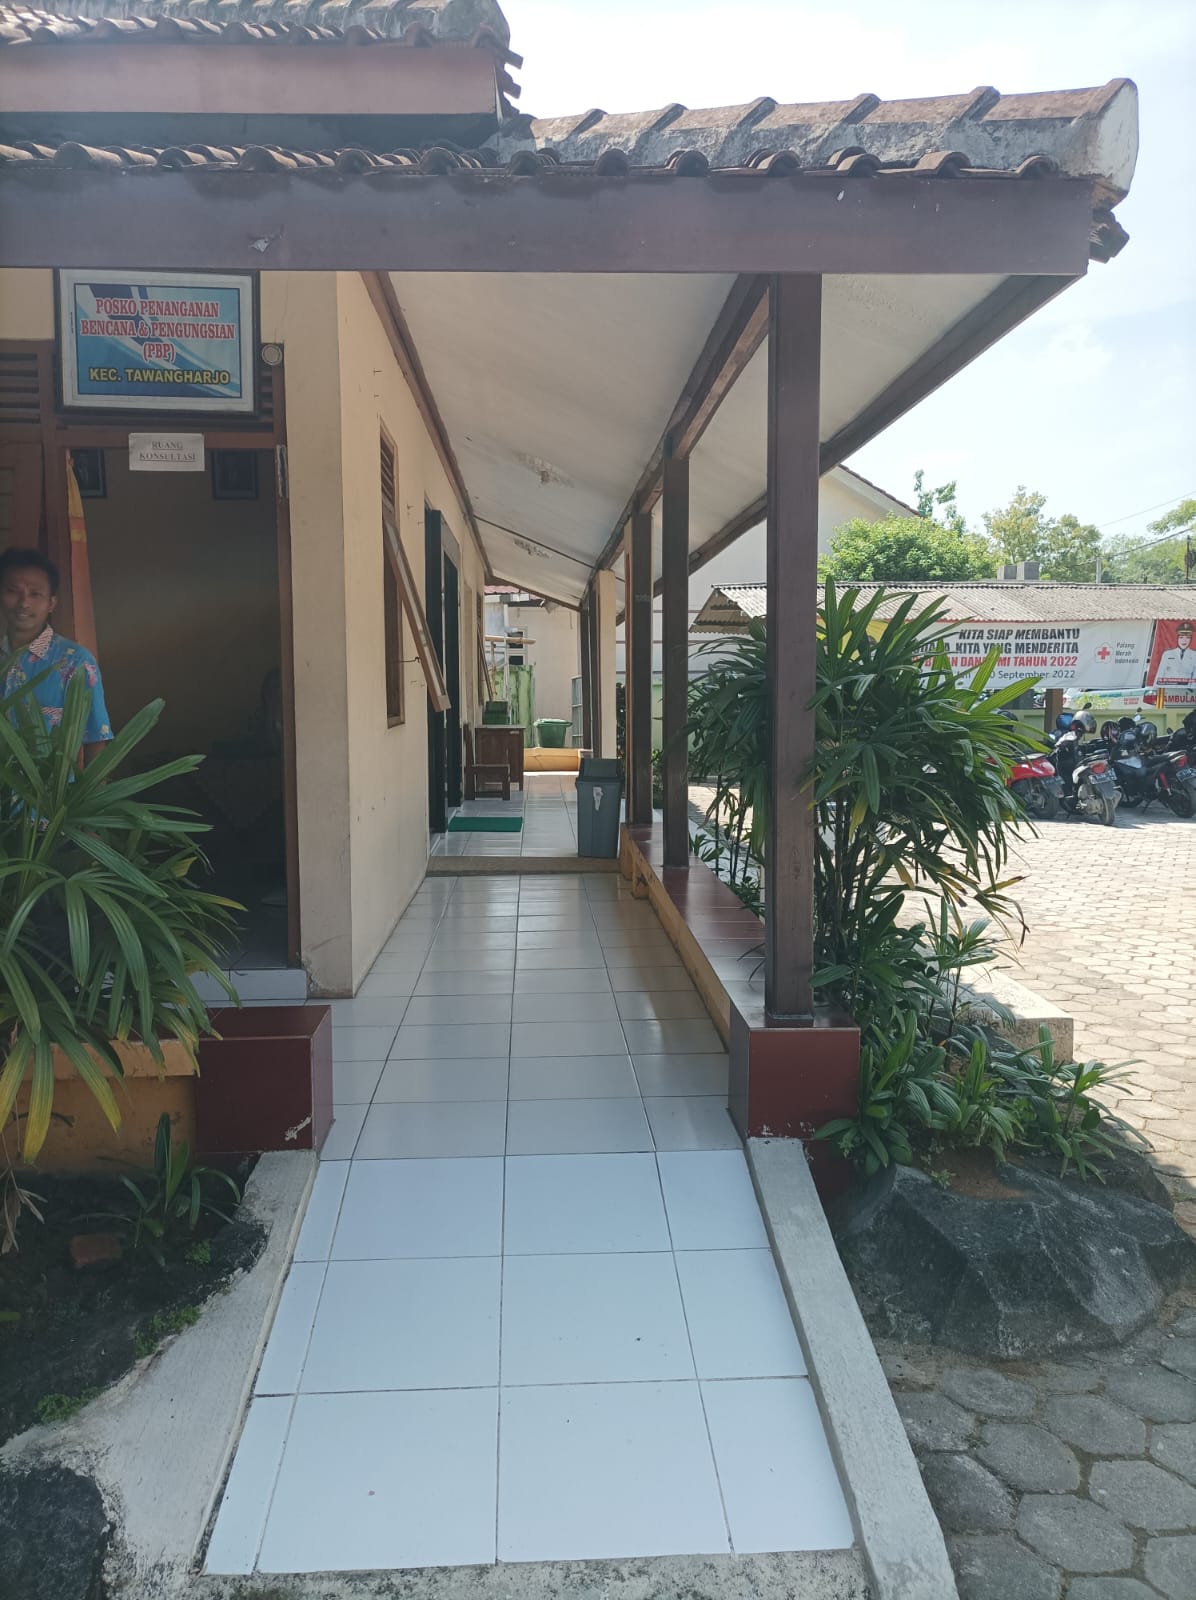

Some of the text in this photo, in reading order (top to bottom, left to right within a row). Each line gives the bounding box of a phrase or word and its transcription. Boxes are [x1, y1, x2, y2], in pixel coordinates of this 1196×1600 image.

[96, 299, 219, 317] POSKO PENANGANAN
[81, 320, 136, 336] BENCANA
[138, 323, 149, 337] &
[151, 322, 235, 338] PENGUNGSIAN
[143, 342, 175, 362] (PBP)
[90, 367, 230, 384] KEC. TAWANGHARJO
[152, 440, 184, 449] RUANG
[140, 452, 196, 461] KONSULTASI
[958, 628, 1080, 640] KITA SIAP MEMBANTU
[956, 642, 980, 654] KITA
[1015, 642, 1079, 654] MENDERITA
[1014, 656, 1048, 667] TAHUN
[1050, 656, 1078, 667] 2022
[998, 670, 1050, 680] September
[1052, 670, 1076, 679] 2022
